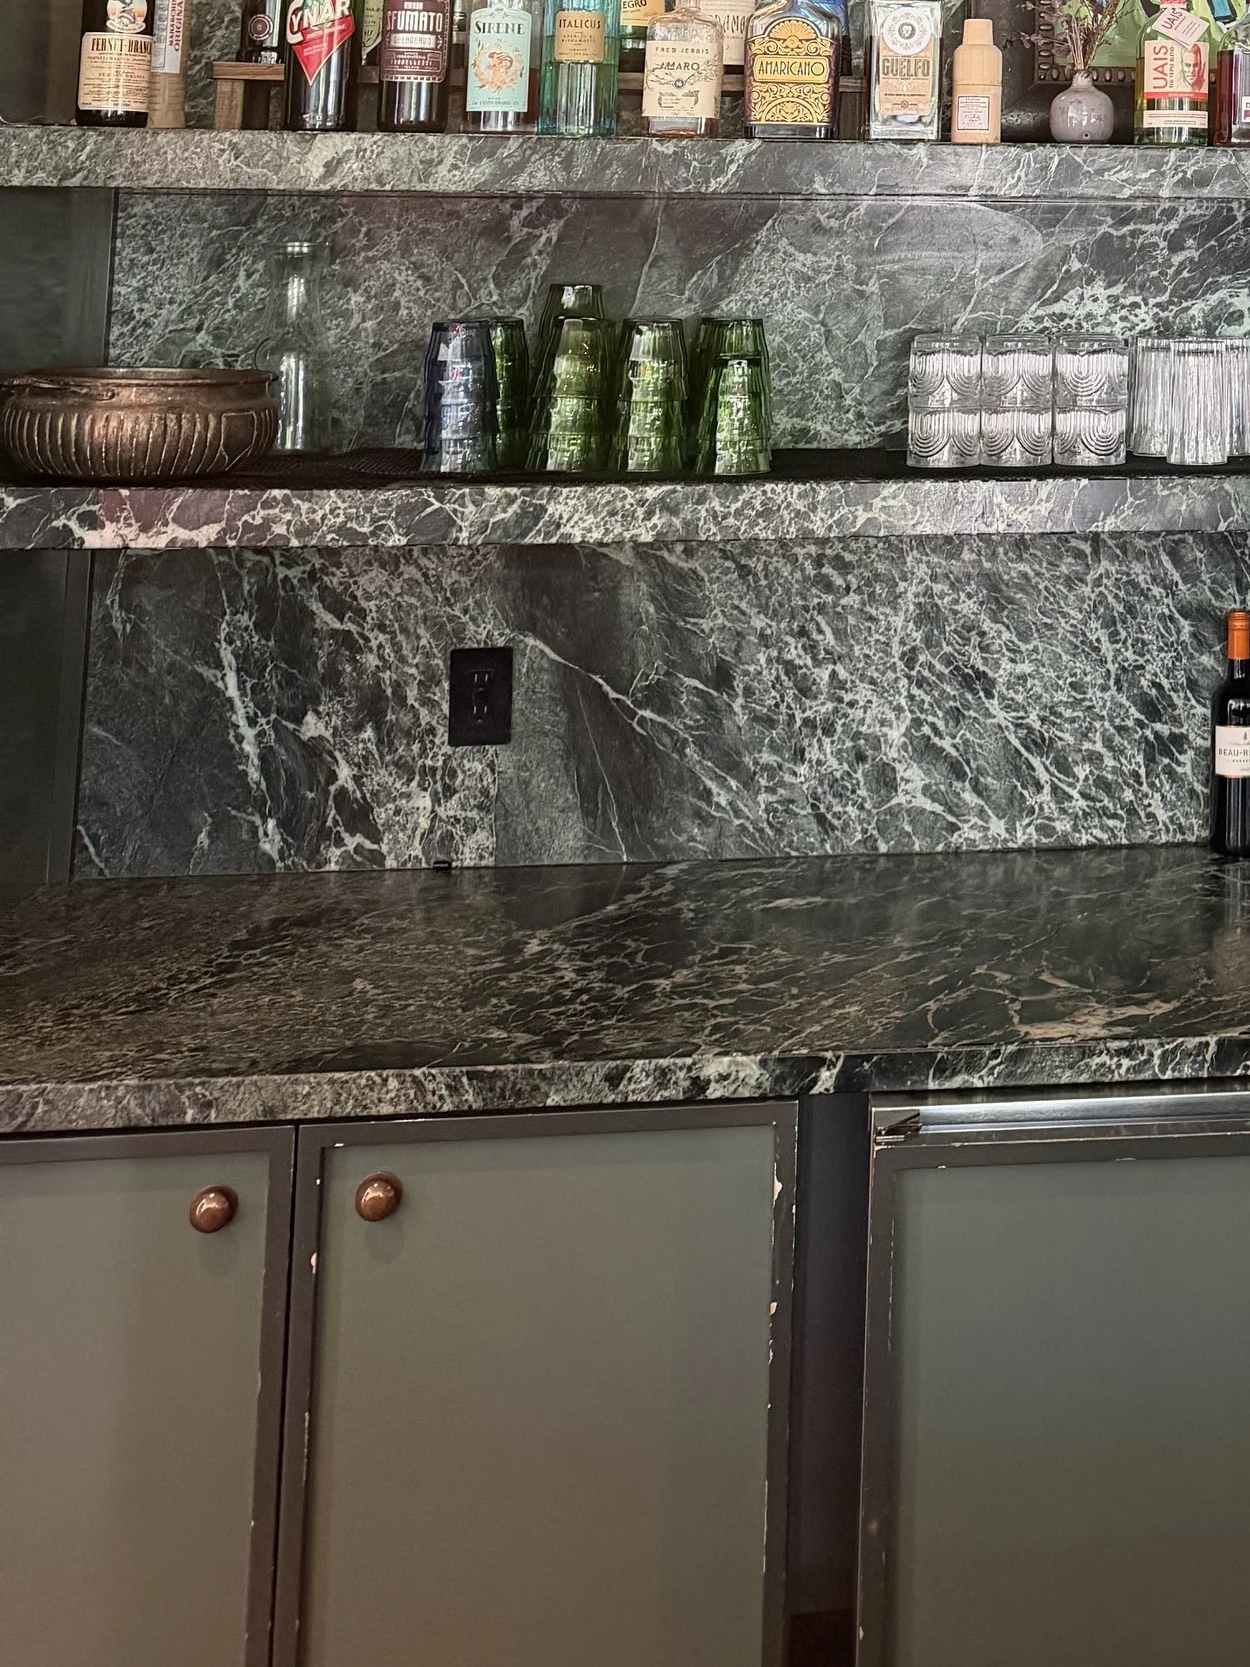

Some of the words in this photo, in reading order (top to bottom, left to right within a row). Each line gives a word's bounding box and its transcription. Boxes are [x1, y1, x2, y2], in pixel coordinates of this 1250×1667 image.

[386, 10, 443, 32] SFUMATO
[474, 20, 525, 35] SIRENE
[558, 18, 602, 30] ITALICUS
[91, 37, 153, 54] FERNET-BRANC
[655, 46, 677, 54] FRED
[659, 61, 700, 72] AMARO
[758, 60, 825, 77] AMARICANO
[881, 57, 930, 78] GUELFO
[1152, 45, 1169, 90] UAIS
